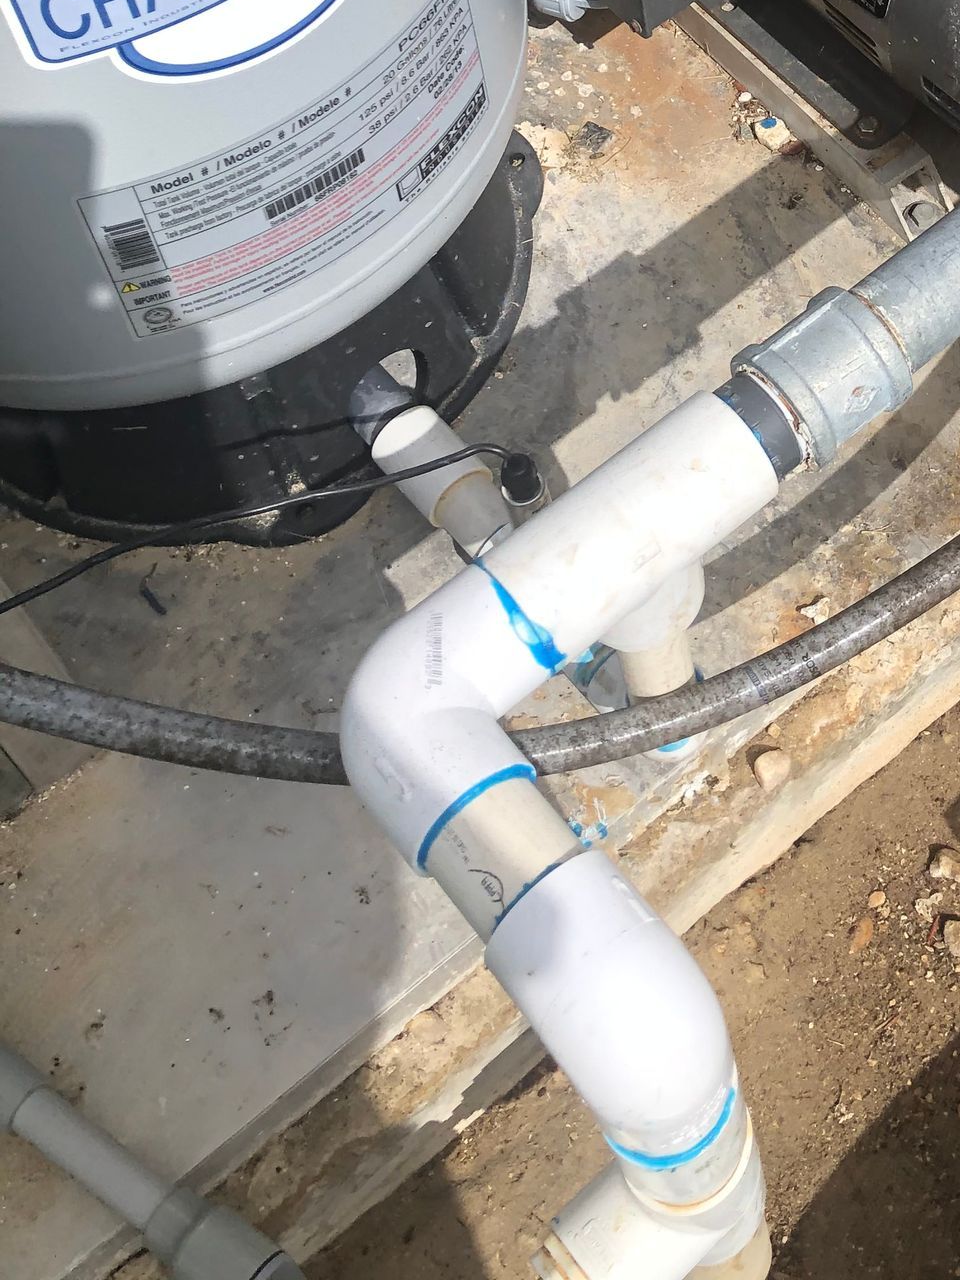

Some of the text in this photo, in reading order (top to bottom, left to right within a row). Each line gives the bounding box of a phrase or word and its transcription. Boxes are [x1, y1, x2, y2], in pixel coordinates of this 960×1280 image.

[359, 100, 378, 121] 125
[379, 86, 394, 111] psi
[415, 53, 431, 76] Bar
[382, 70, 395, 85] 20
[396, 38, 427, 70] Gallons
[427, 44, 465, 94] Date Code:
[368, 120, 382, 134] 38
[383, 108, 398, 127] psi
[419, 67, 434, 90] Bar
[421, 90, 484, 164] FLEXCON
[151, 172, 194, 194] Model
[224, 139, 271, 167] Modelo
[298, 96, 340, 127] Modele
[133, 288, 171, 307] IMPORTANT
[139, 273, 171, 289] WARNING
